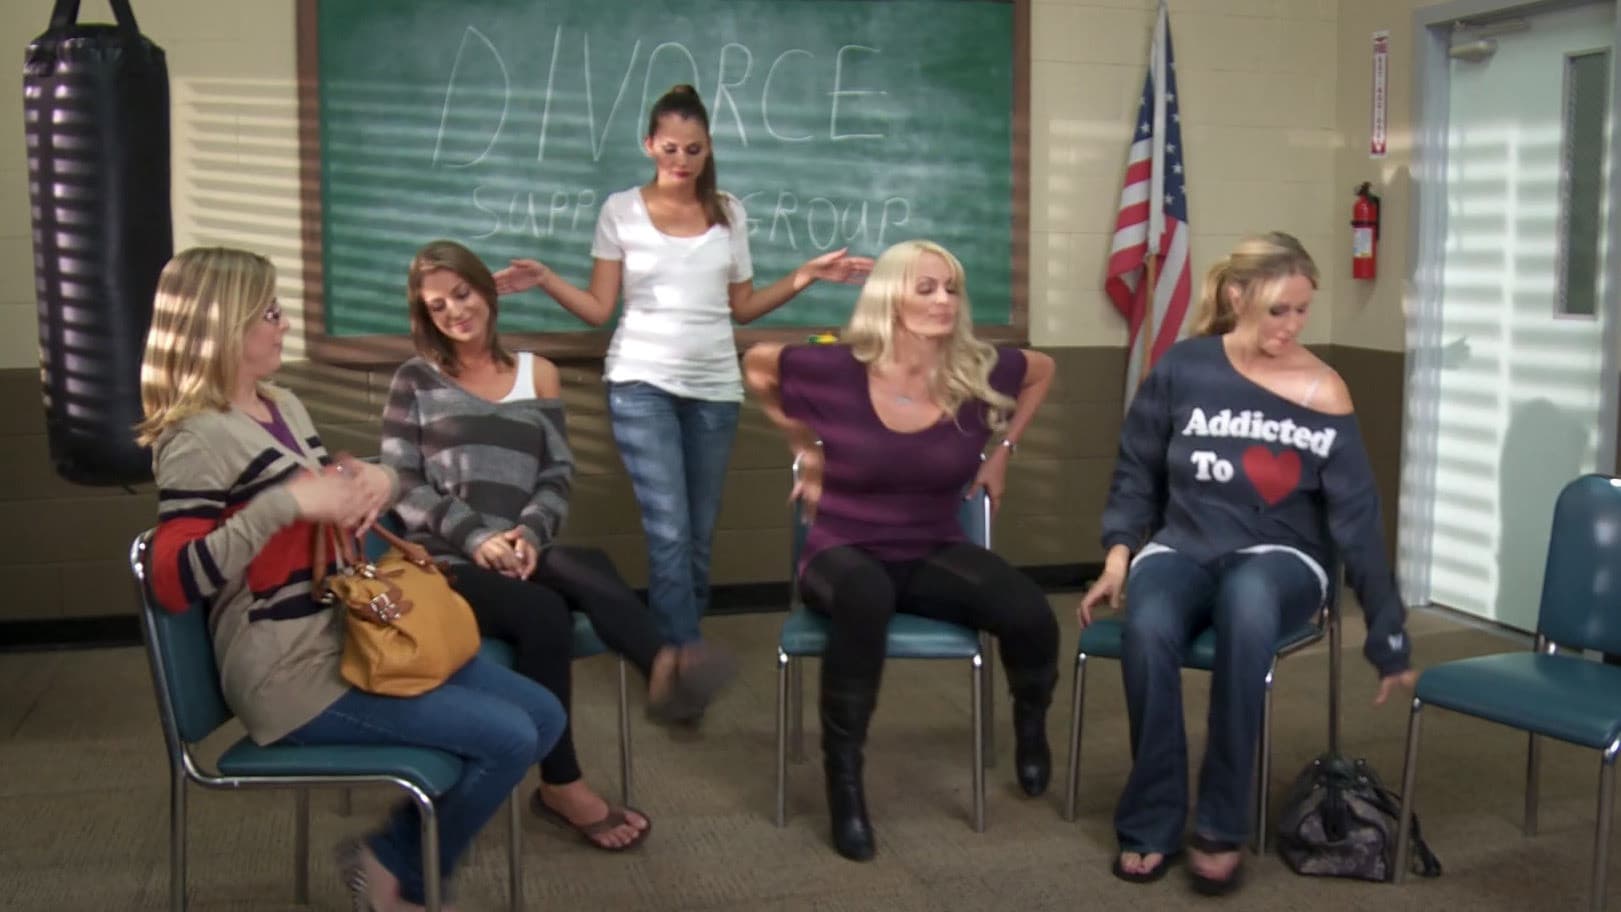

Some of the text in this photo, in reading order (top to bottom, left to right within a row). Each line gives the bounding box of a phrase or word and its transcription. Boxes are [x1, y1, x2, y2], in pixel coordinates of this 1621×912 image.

[431, 25, 888, 168] DIVORCE
[472, 184, 597, 239] SUPP
[1181, 407, 1338, 458] Addicted
[1190, 450, 1235, 483] To
